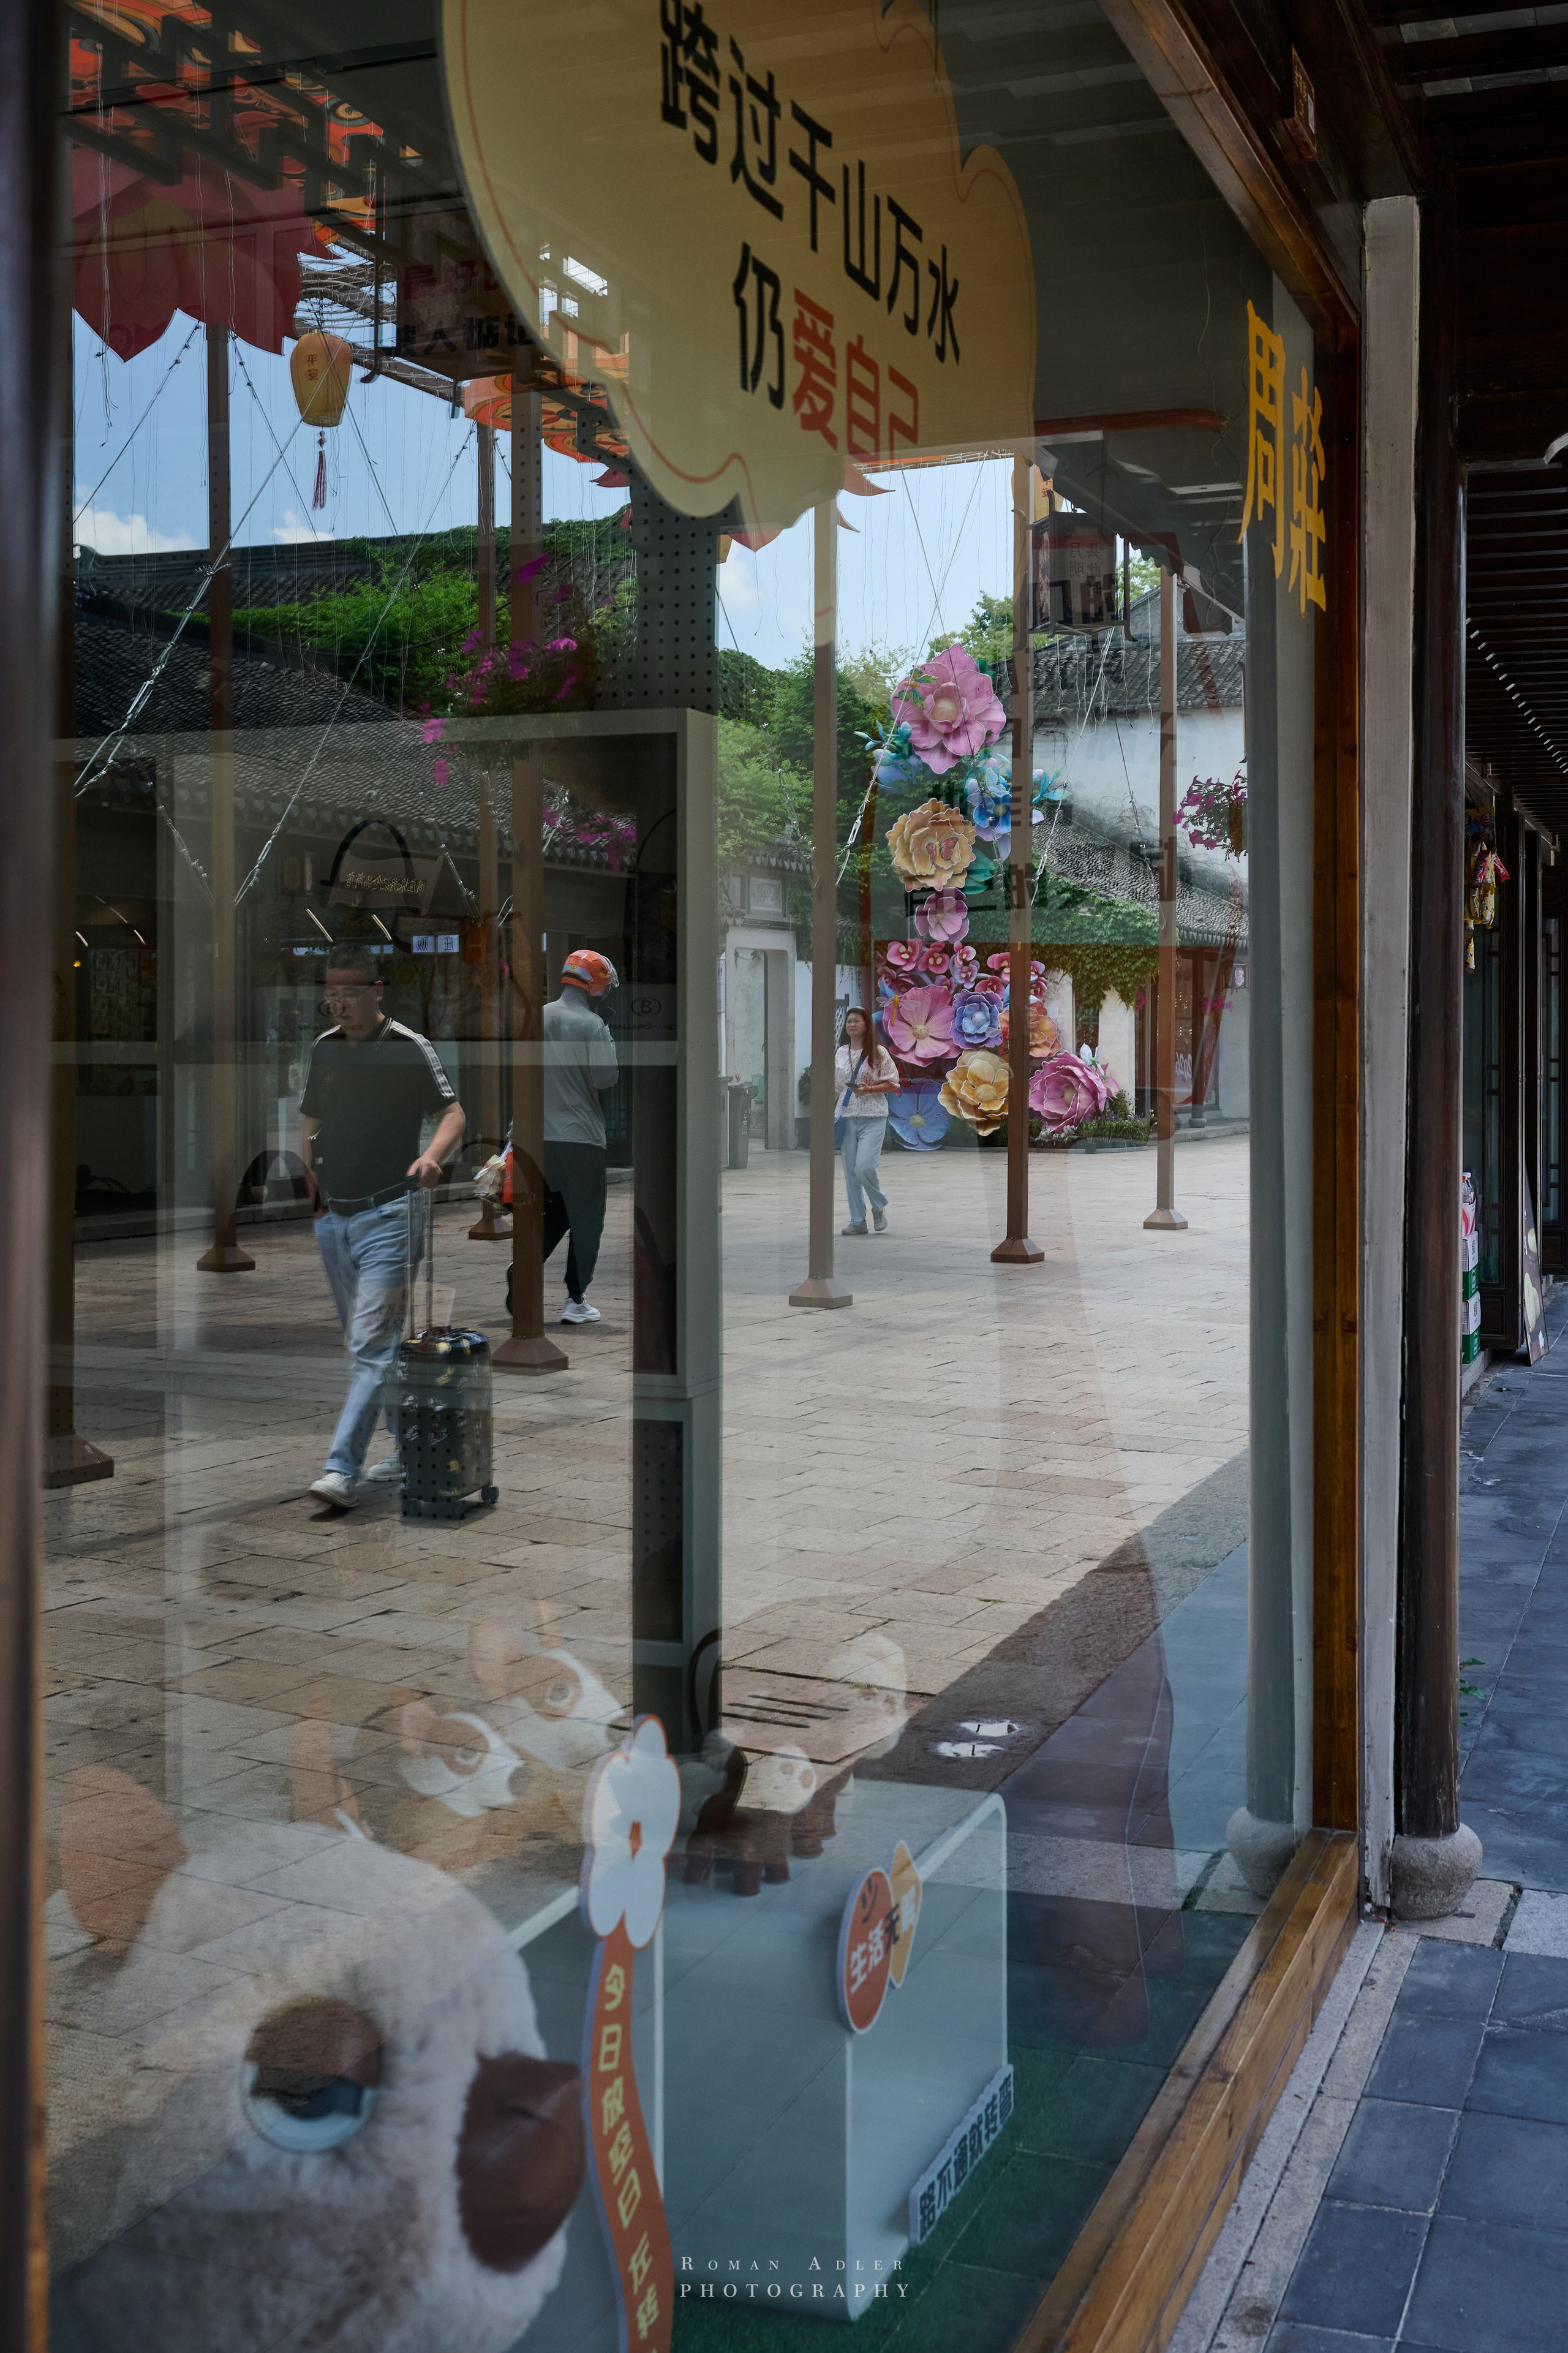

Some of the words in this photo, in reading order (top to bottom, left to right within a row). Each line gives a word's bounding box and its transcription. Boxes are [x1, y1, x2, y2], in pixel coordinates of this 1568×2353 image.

[660, 0, 960, 366] 跨过千山万水
[733, 241, 919, 464] 仍爱自己
[919, 2071, 1014, 2242] 路不通就转弯
